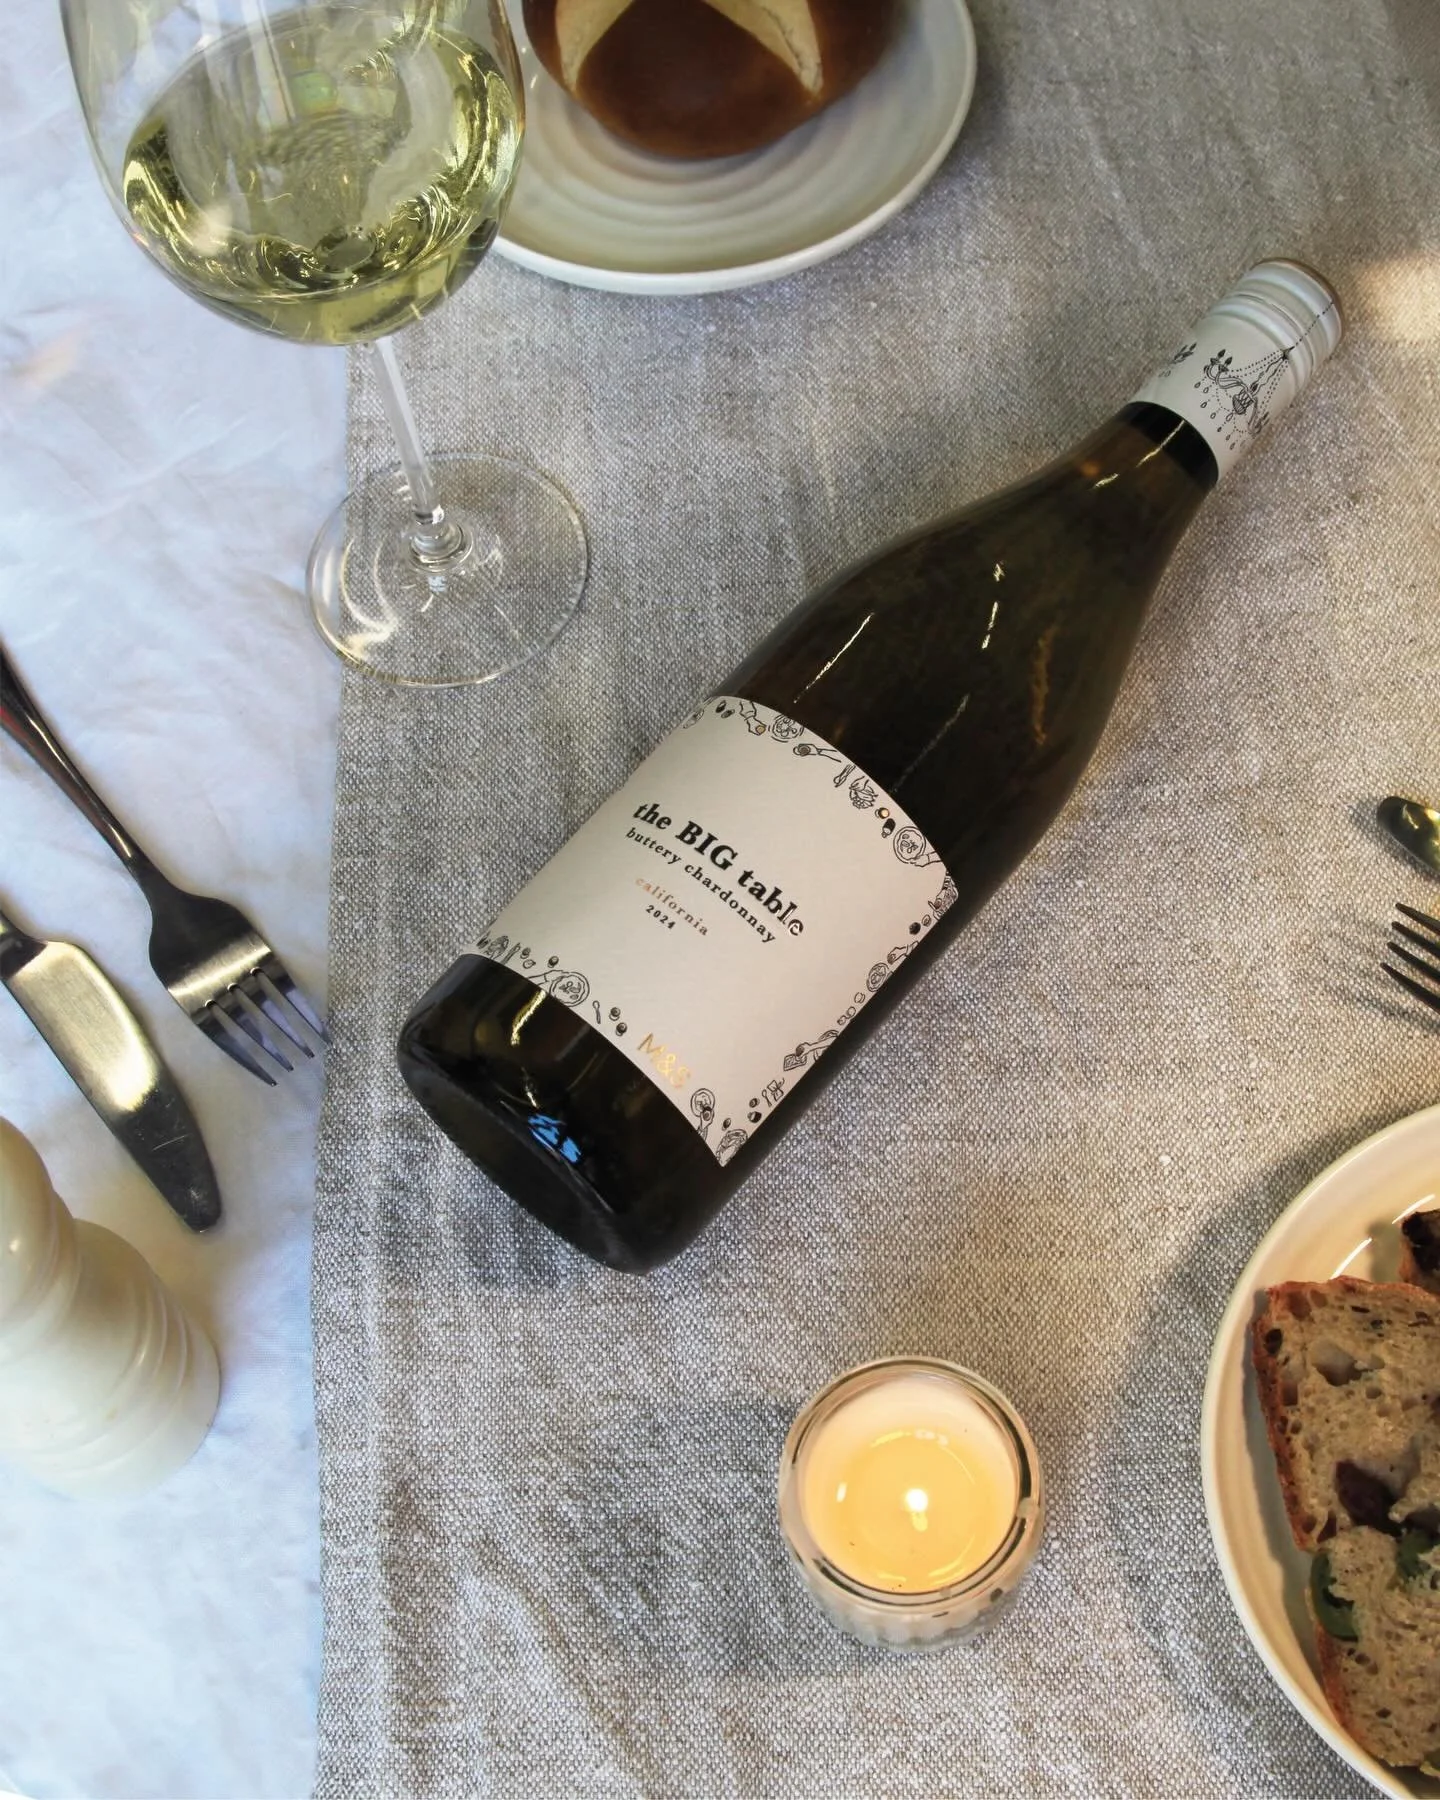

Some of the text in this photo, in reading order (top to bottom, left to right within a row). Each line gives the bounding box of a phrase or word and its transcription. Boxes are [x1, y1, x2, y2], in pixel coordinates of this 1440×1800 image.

[625, 827, 776, 944] buttery chardonnay
[632, 802, 805, 937] the BIG table
[634, 876, 709, 936] california
[645, 904, 677, 930] 2024
[637, 1032, 691, 1089] M&S
